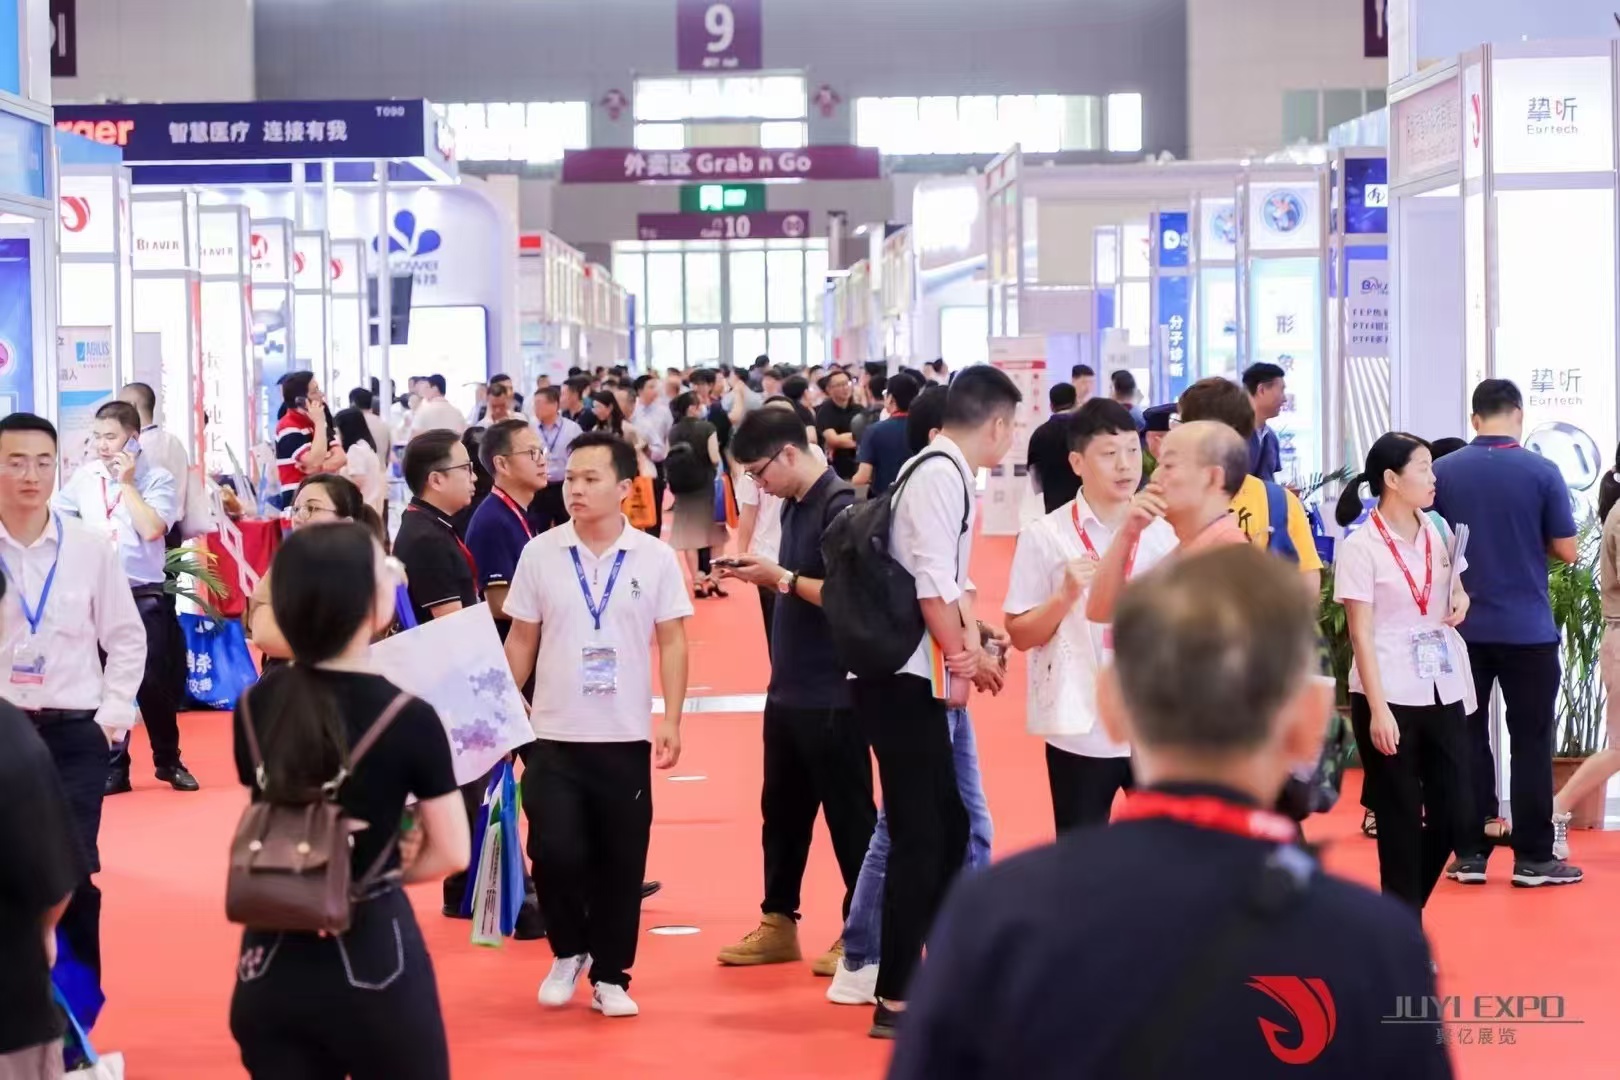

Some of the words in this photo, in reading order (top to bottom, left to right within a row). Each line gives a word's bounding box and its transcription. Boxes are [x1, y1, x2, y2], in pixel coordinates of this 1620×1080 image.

[704, 4, 735, 53] 9
[1527, 97, 1577, 122] 挚听
[168, 121, 250, 144] 智慧医疗
[263, 119, 348, 142] 连接有我
[1526, 124, 1578, 135] Eartech
[624, 153, 692, 176] 外卖区
[696, 152, 754, 174] Grab
[758, 156, 773, 172] n
[778, 152, 812, 172] Go
[725, 215, 751, 238] 10
[1530, 368, 1582, 393] 挚听
[1529, 395, 1582, 406] Eartech
